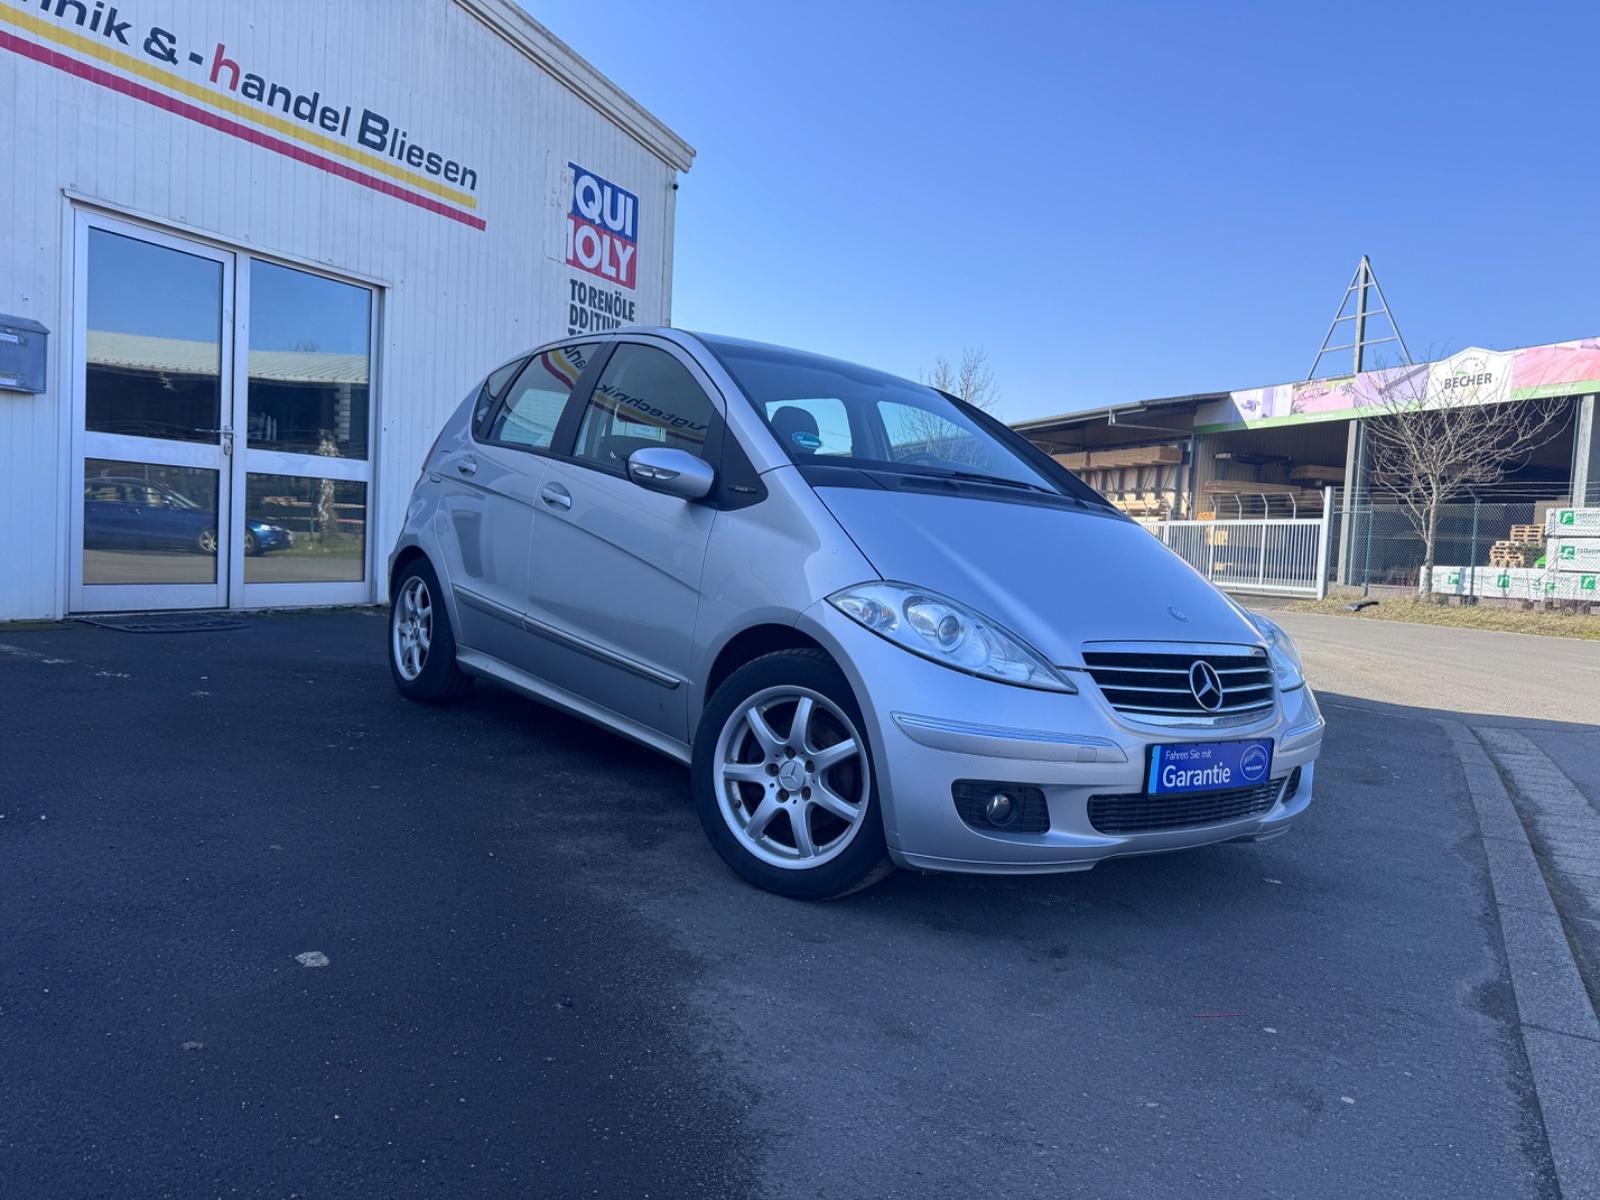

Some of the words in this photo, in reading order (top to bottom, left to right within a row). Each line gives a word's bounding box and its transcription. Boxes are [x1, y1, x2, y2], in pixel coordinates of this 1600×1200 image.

[143, 26, 179, 65] &
[357, 108, 478, 191] Bliesen
[1443, 372, 1493, 390] BECHER
[1165, 750, 1189, 761] Fahren
[1190, 749, 1201, 759] Sie
[1201, 749, 1212, 759] mit
[1162, 762, 1231, 788] Garantie
